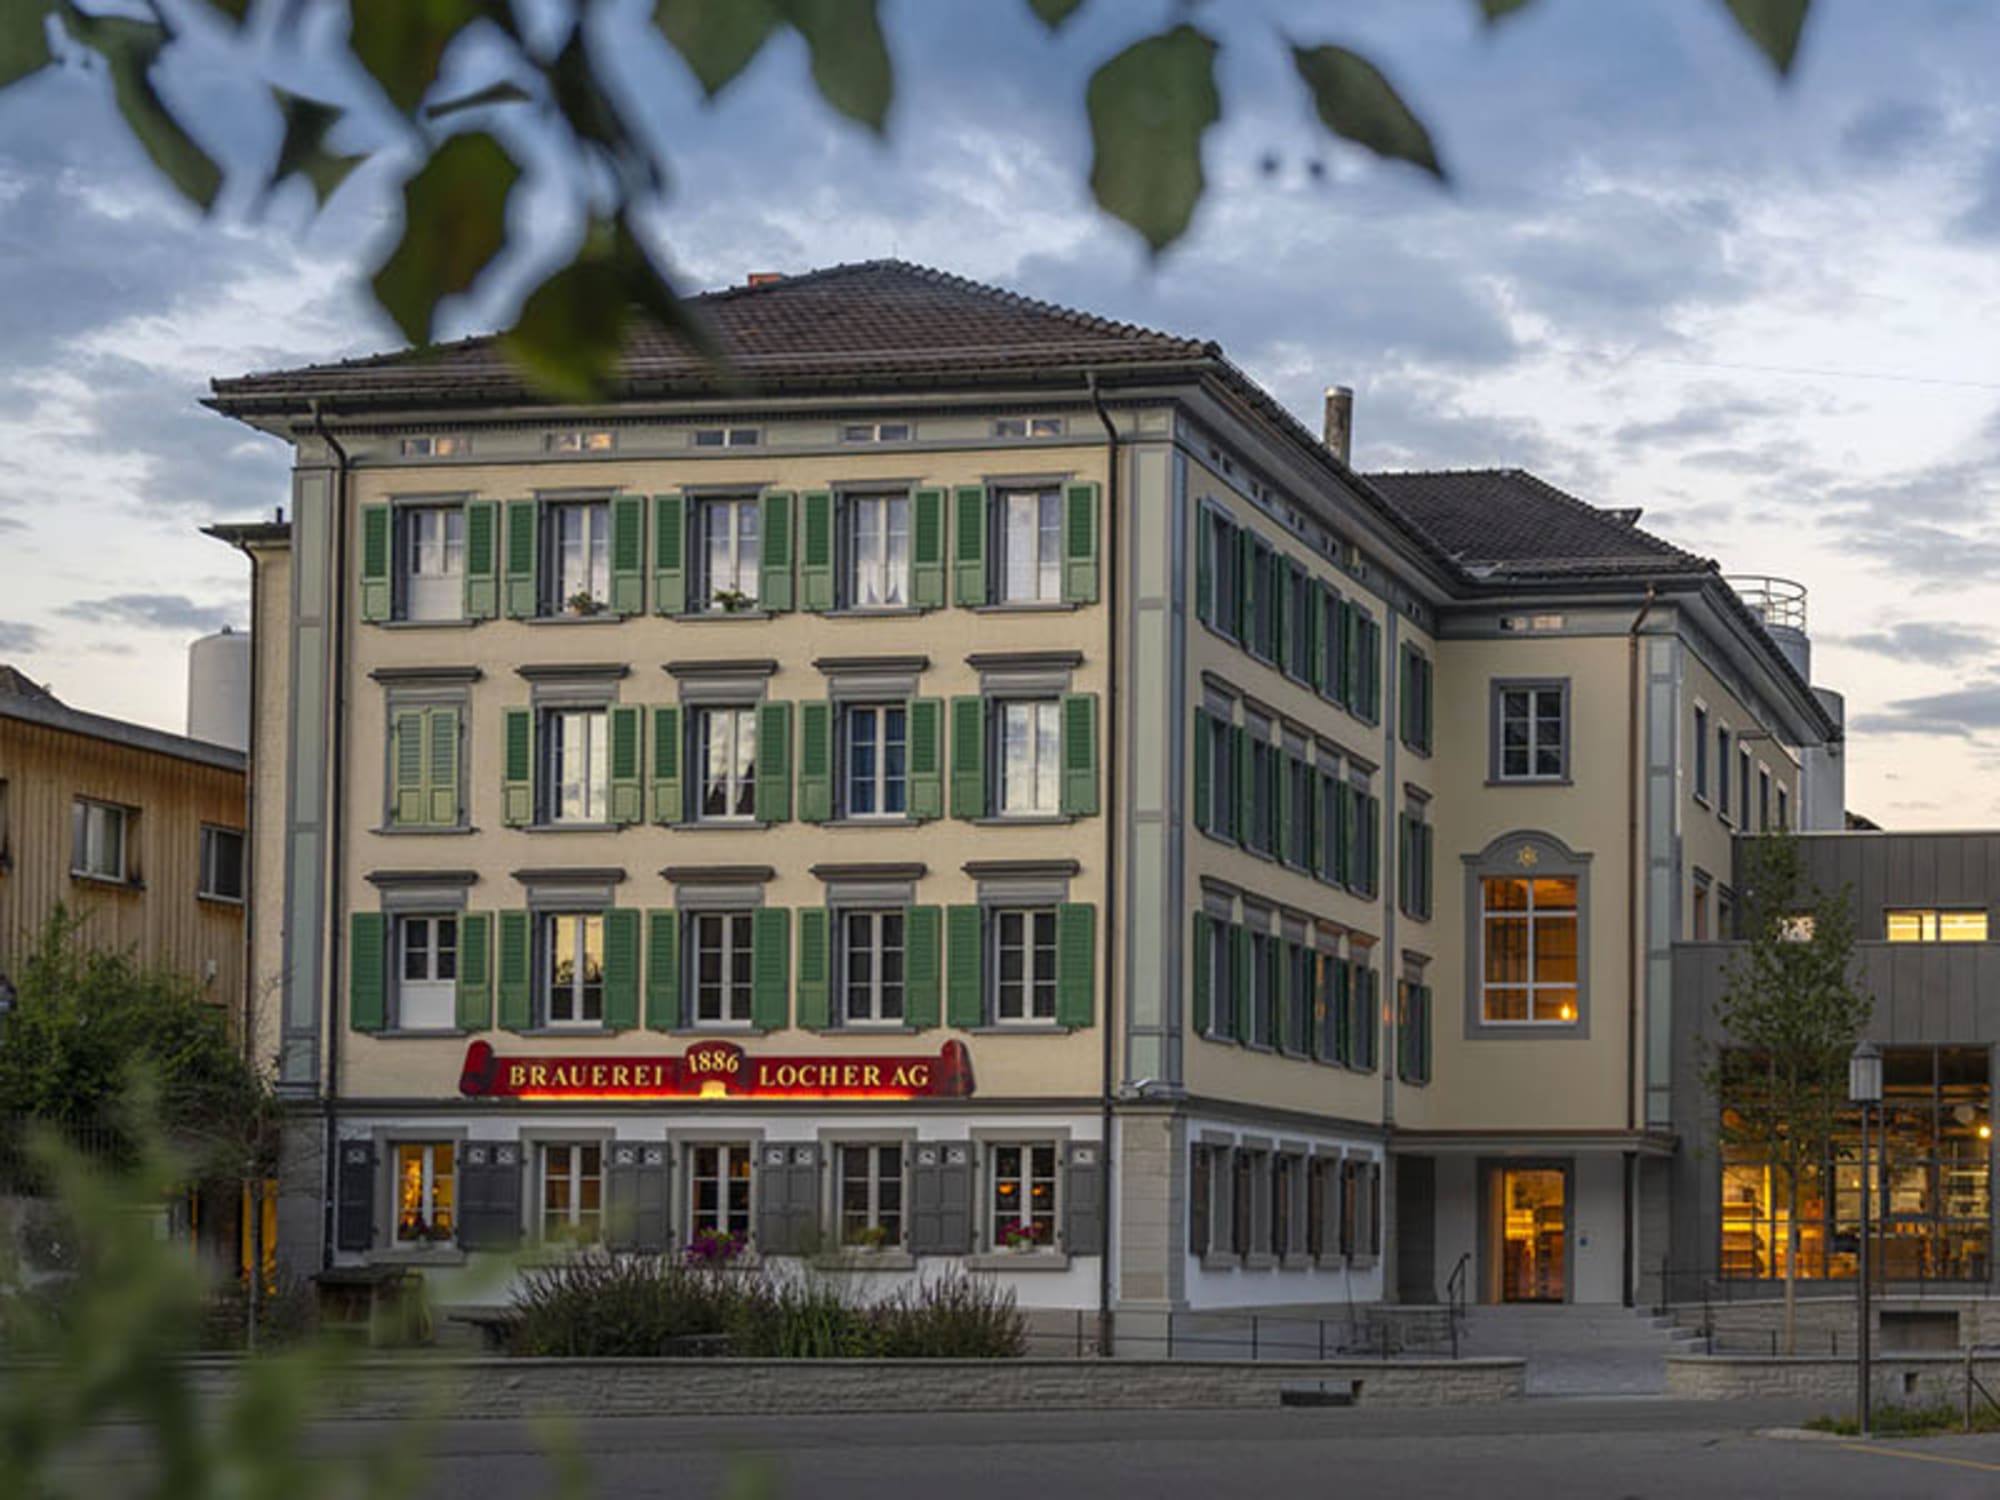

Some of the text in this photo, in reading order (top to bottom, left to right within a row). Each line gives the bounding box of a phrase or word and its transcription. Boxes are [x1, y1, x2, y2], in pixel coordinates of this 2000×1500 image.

[689, 1050, 739, 1073] 1886
[510, 1064, 928, 1087] BRAUEREI LOCHER AG
